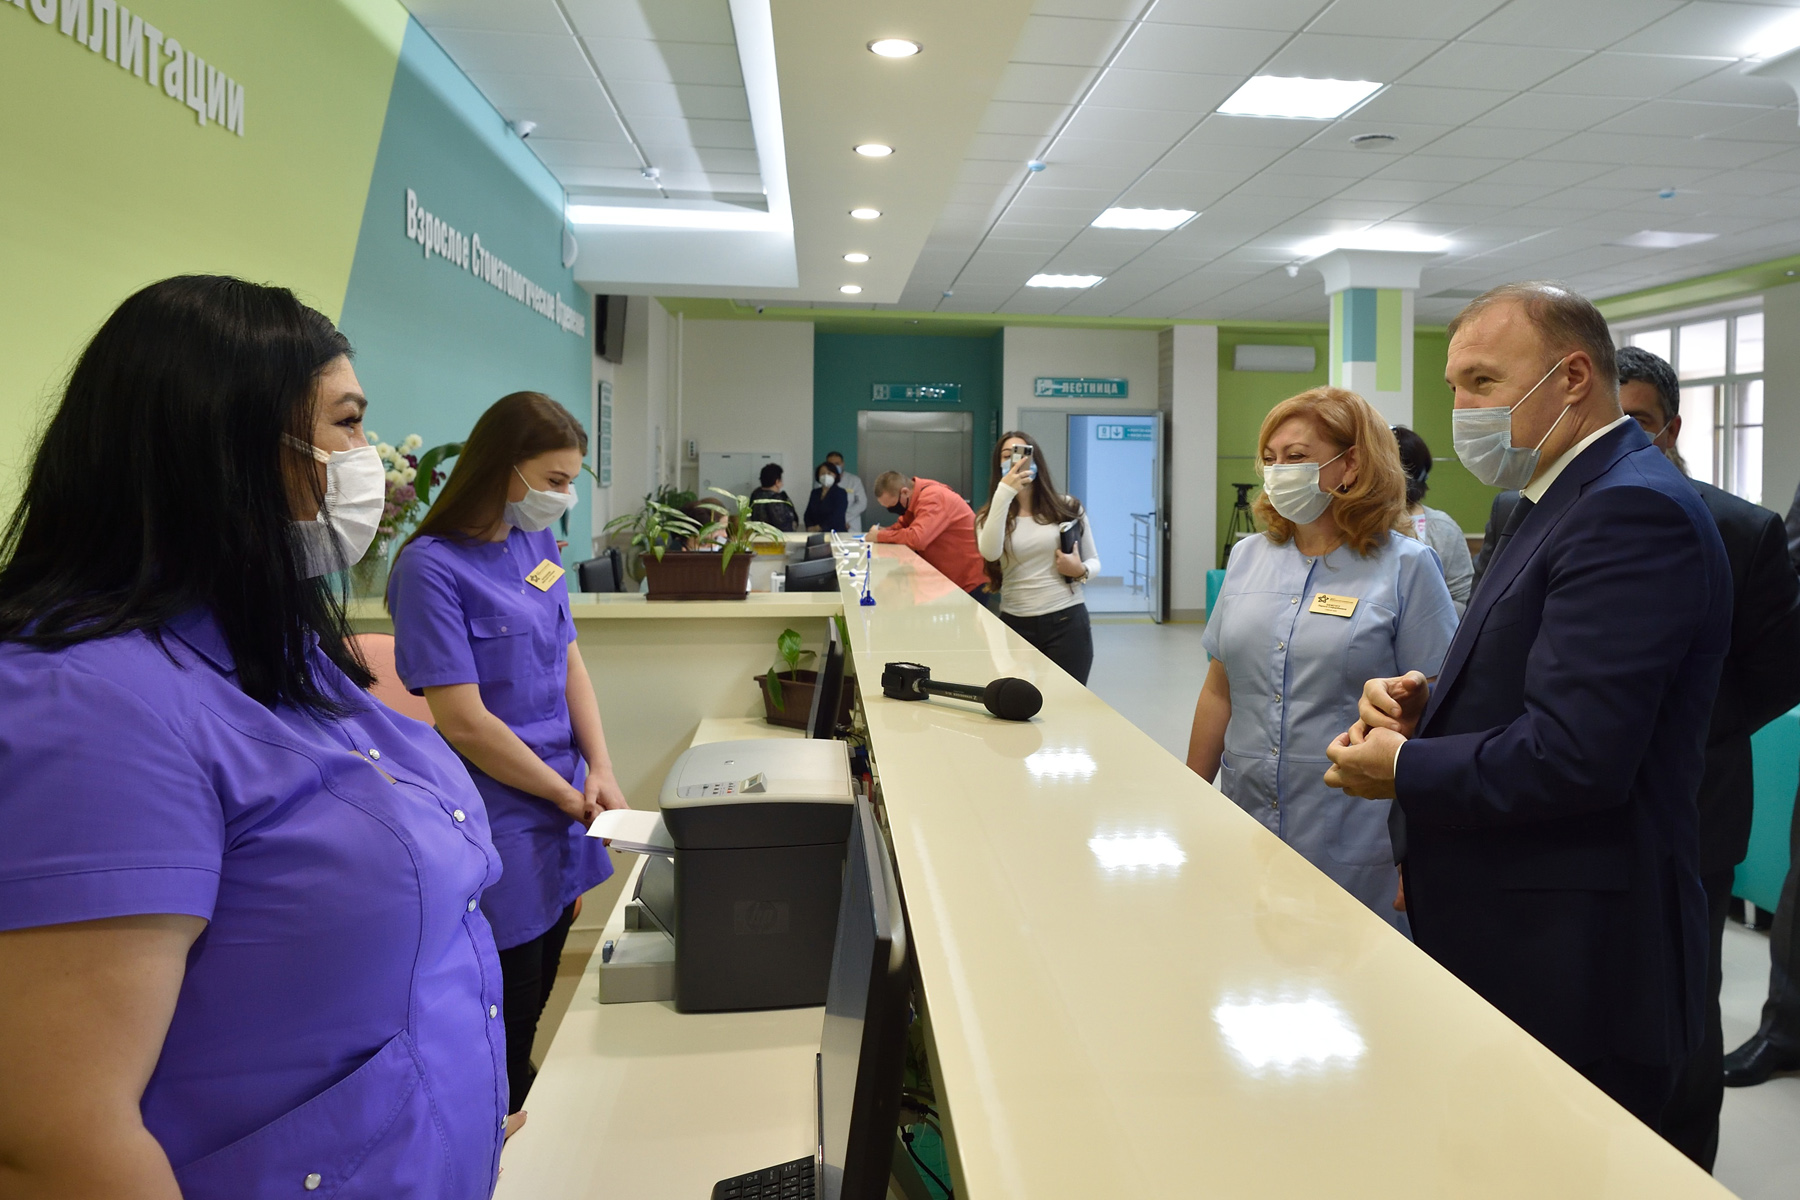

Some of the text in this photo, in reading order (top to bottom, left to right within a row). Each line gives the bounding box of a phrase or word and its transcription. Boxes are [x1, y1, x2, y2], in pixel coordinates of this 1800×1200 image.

[4, 0, 244, 137] илитации
[406, 187, 469, 270] Взрослое
[1061, 382, 1118, 395] ЛЕСТНИЦА
